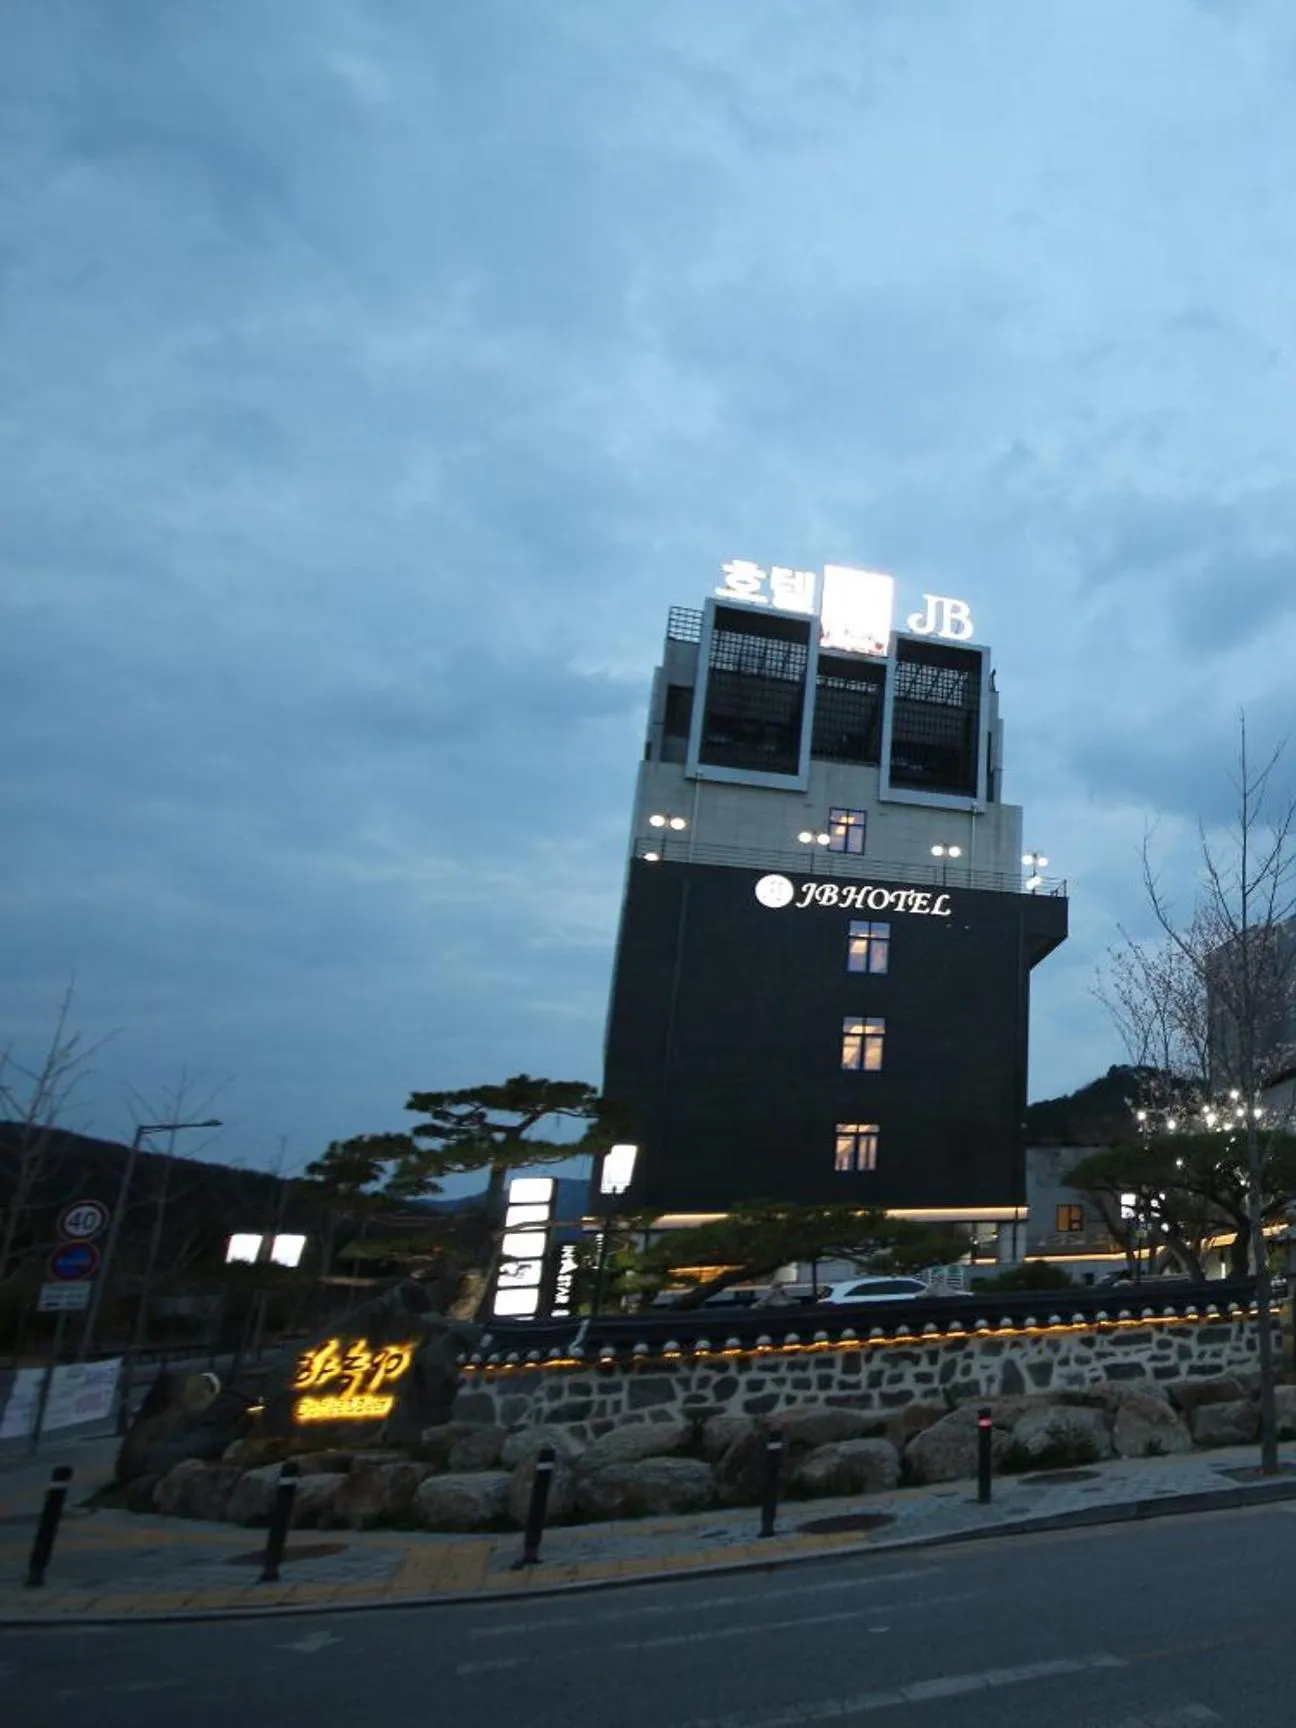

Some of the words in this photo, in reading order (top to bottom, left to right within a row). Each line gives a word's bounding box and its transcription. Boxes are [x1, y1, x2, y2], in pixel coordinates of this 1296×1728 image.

[715, 559, 816, 615] 호텔
[907, 594, 974, 640] JB
[68, 1211, 97, 1231] 40
